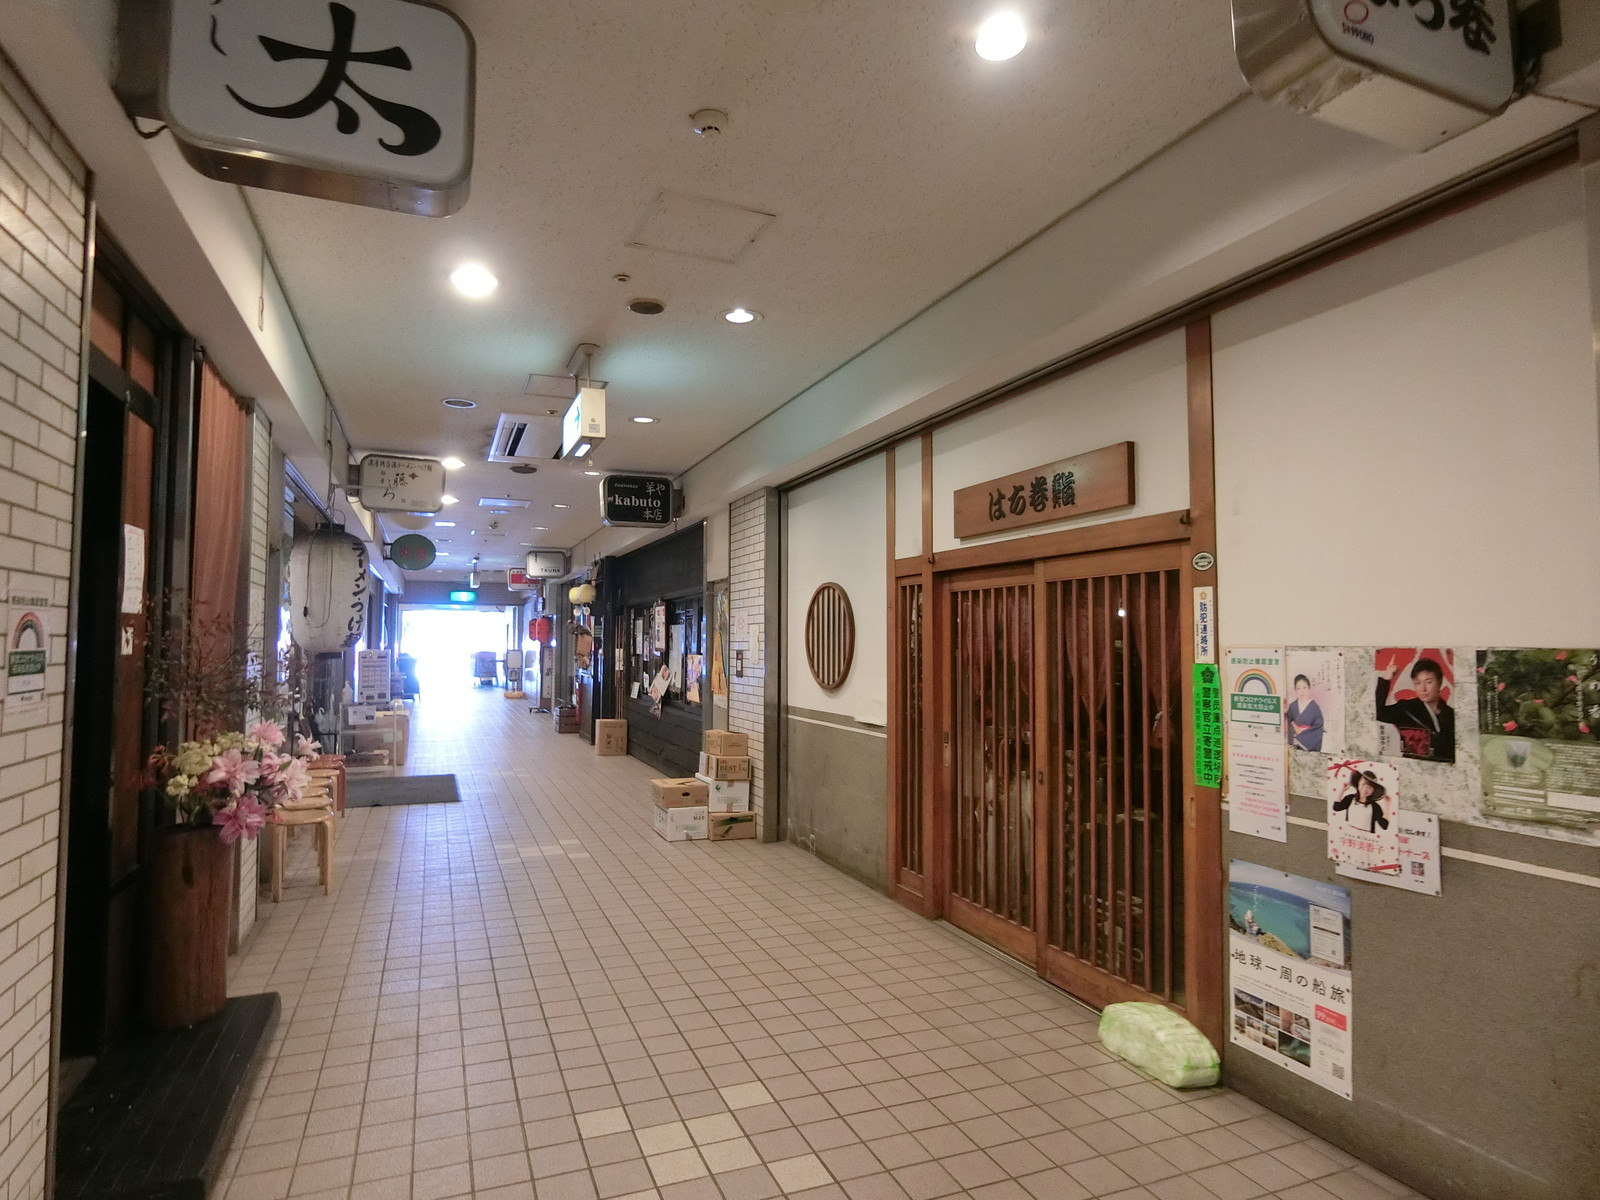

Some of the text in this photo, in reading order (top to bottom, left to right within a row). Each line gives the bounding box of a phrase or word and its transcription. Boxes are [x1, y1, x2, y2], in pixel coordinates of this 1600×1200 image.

[614, 494, 661, 508] kabuto
[646, 481, 666, 496] 羊や
[643, 508, 663, 521] 本店
[1199, 601, 1209, 657] 防犯連絡所
[1202, 686, 1213, 785] 警察官立寄警戒中
[1233, 948, 1347, 1005] 地球一周の船旅
